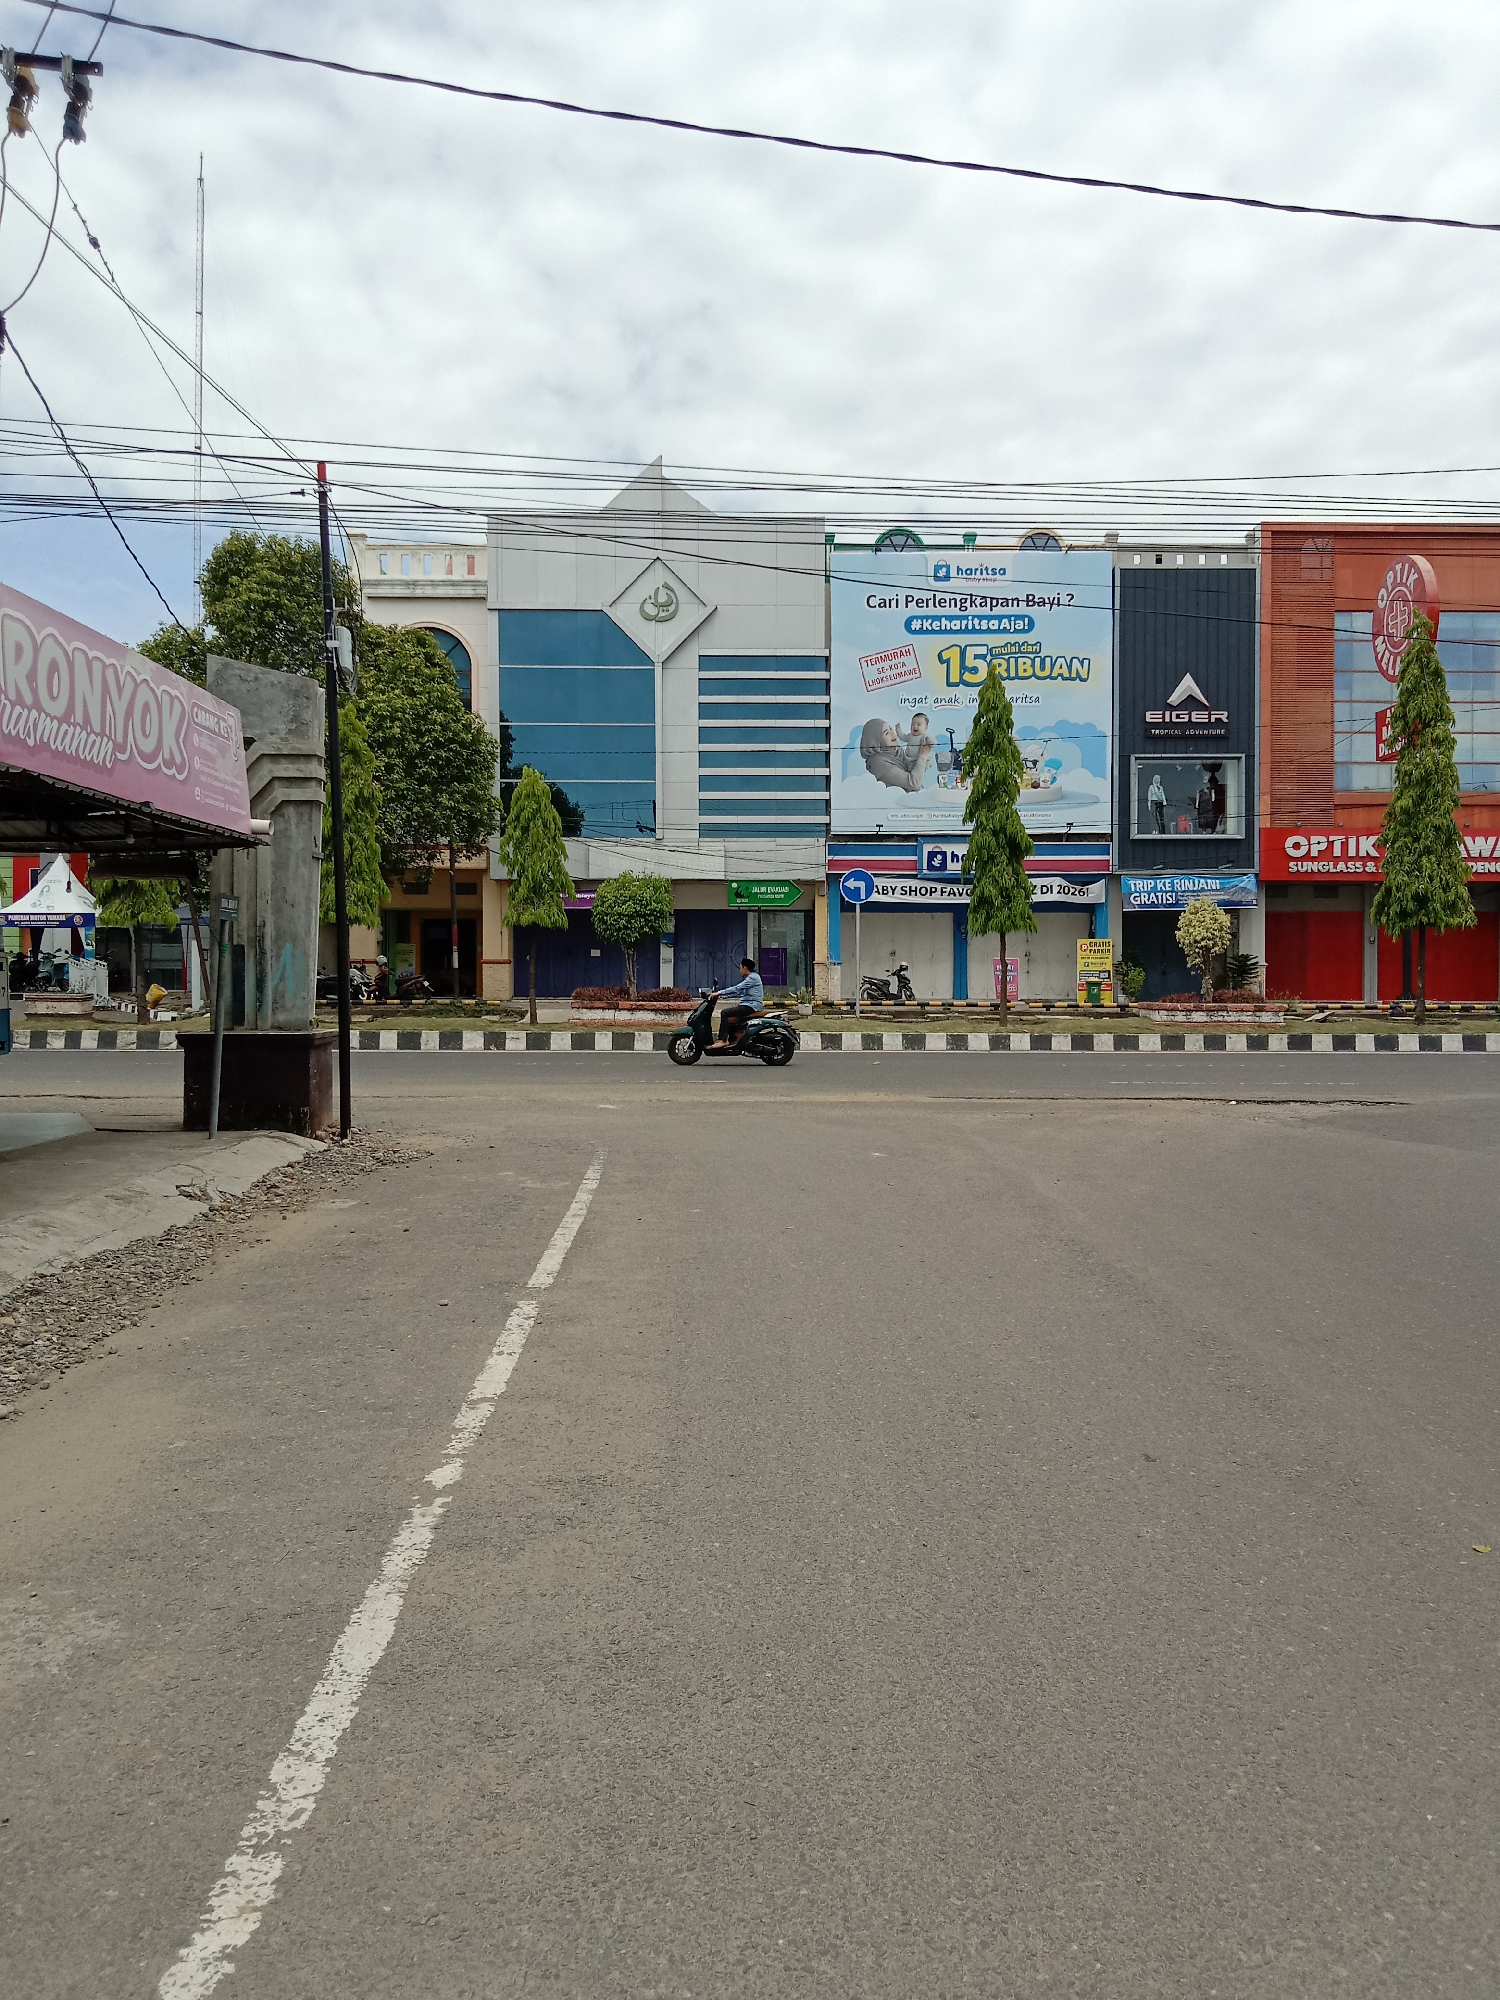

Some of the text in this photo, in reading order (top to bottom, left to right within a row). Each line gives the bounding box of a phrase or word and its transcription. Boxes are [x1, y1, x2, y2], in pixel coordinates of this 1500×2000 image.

[957, 564, 1006, 576] haritsa
[1378, 563, 1419, 609] OPTIK
[866, 594, 898, 609] Cari
[905, 595, 1020, 612] Perlengkapan
[1026, 593, 1061, 612] Bayi
[910, 616, 1029, 633] #KeharitsaAja!
[864, 648, 912, 668] TERMURAH
[940, 642, 1041, 685] 15 mulai dari
[867, 667, 918, 687] LHOKSEUMAWE
[993, 655, 1090, 682] RIBUAN
[2, 617, 183, 765] RONYOK
[900, 694, 928, 706] ingat
[934, 694, 964, 706] anak,
[1009, 694, 1040, 704] aritsa
[193, 707, 219, 734] CABANG
[1145, 710, 1229, 723] EIGER
[0, 693, 115, 768] rasmanan
[1285, 835, 1380, 857] OPTIK
[1288, 861, 1363, 873] SUNGLASS
[1365, 861, 1377, 873] &
[874, 885, 897, 896] ABY
[900, 885, 937, 897] SHOP
[1040, 884, 1053, 895] DI
[1129, 879, 1220, 892] TRIP KE RINJANI
[1130, 892, 1176, 905] GRATIS!
